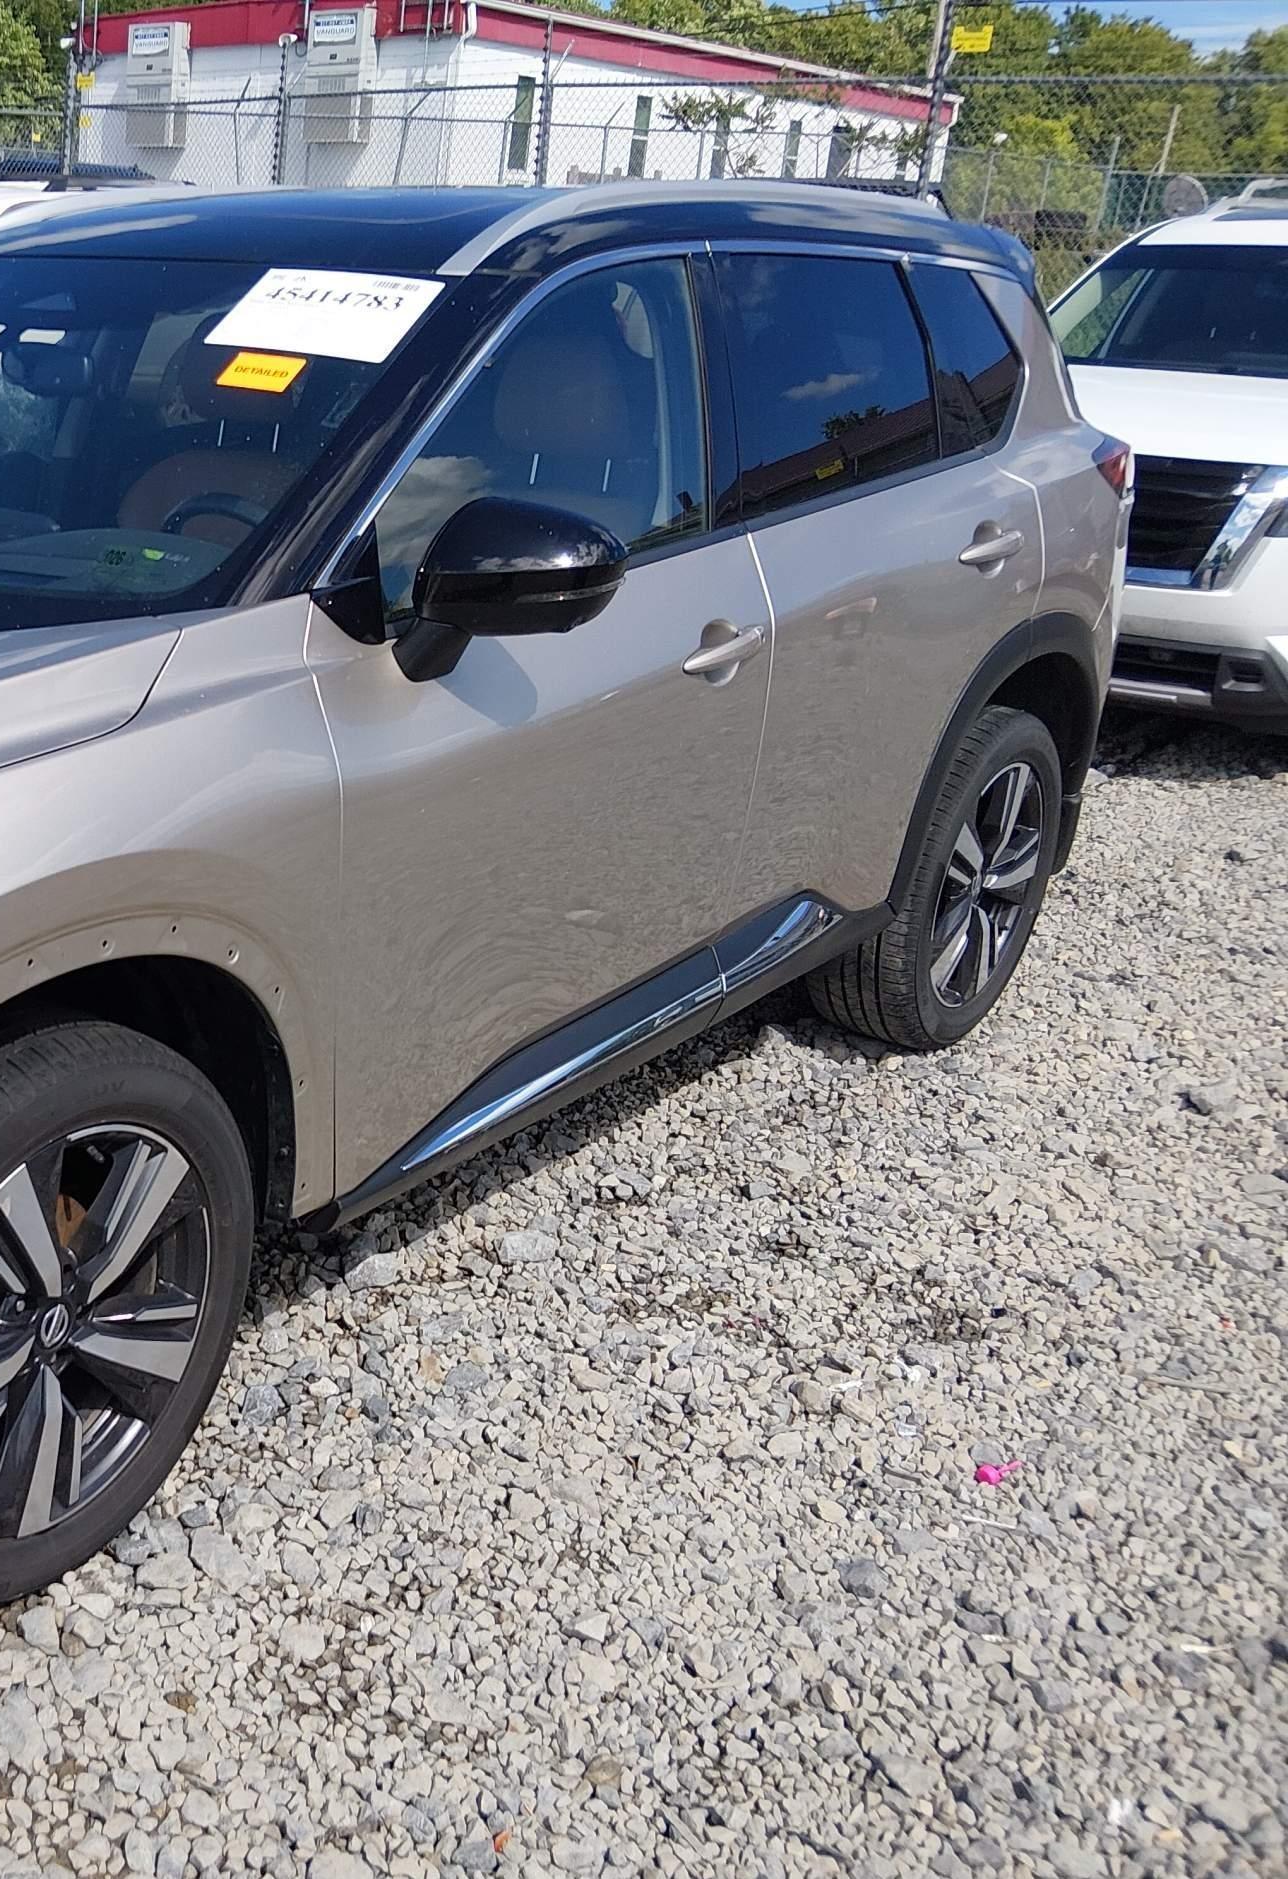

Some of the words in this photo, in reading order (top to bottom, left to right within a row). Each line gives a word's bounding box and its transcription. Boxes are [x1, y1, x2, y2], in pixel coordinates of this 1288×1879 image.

[316, 27, 355, 36] VANGUARD
[135, 39, 168, 49] VANGUARD
[265, 287, 404, 312] 45414783
[234, 365, 289, 378] DETAILED
